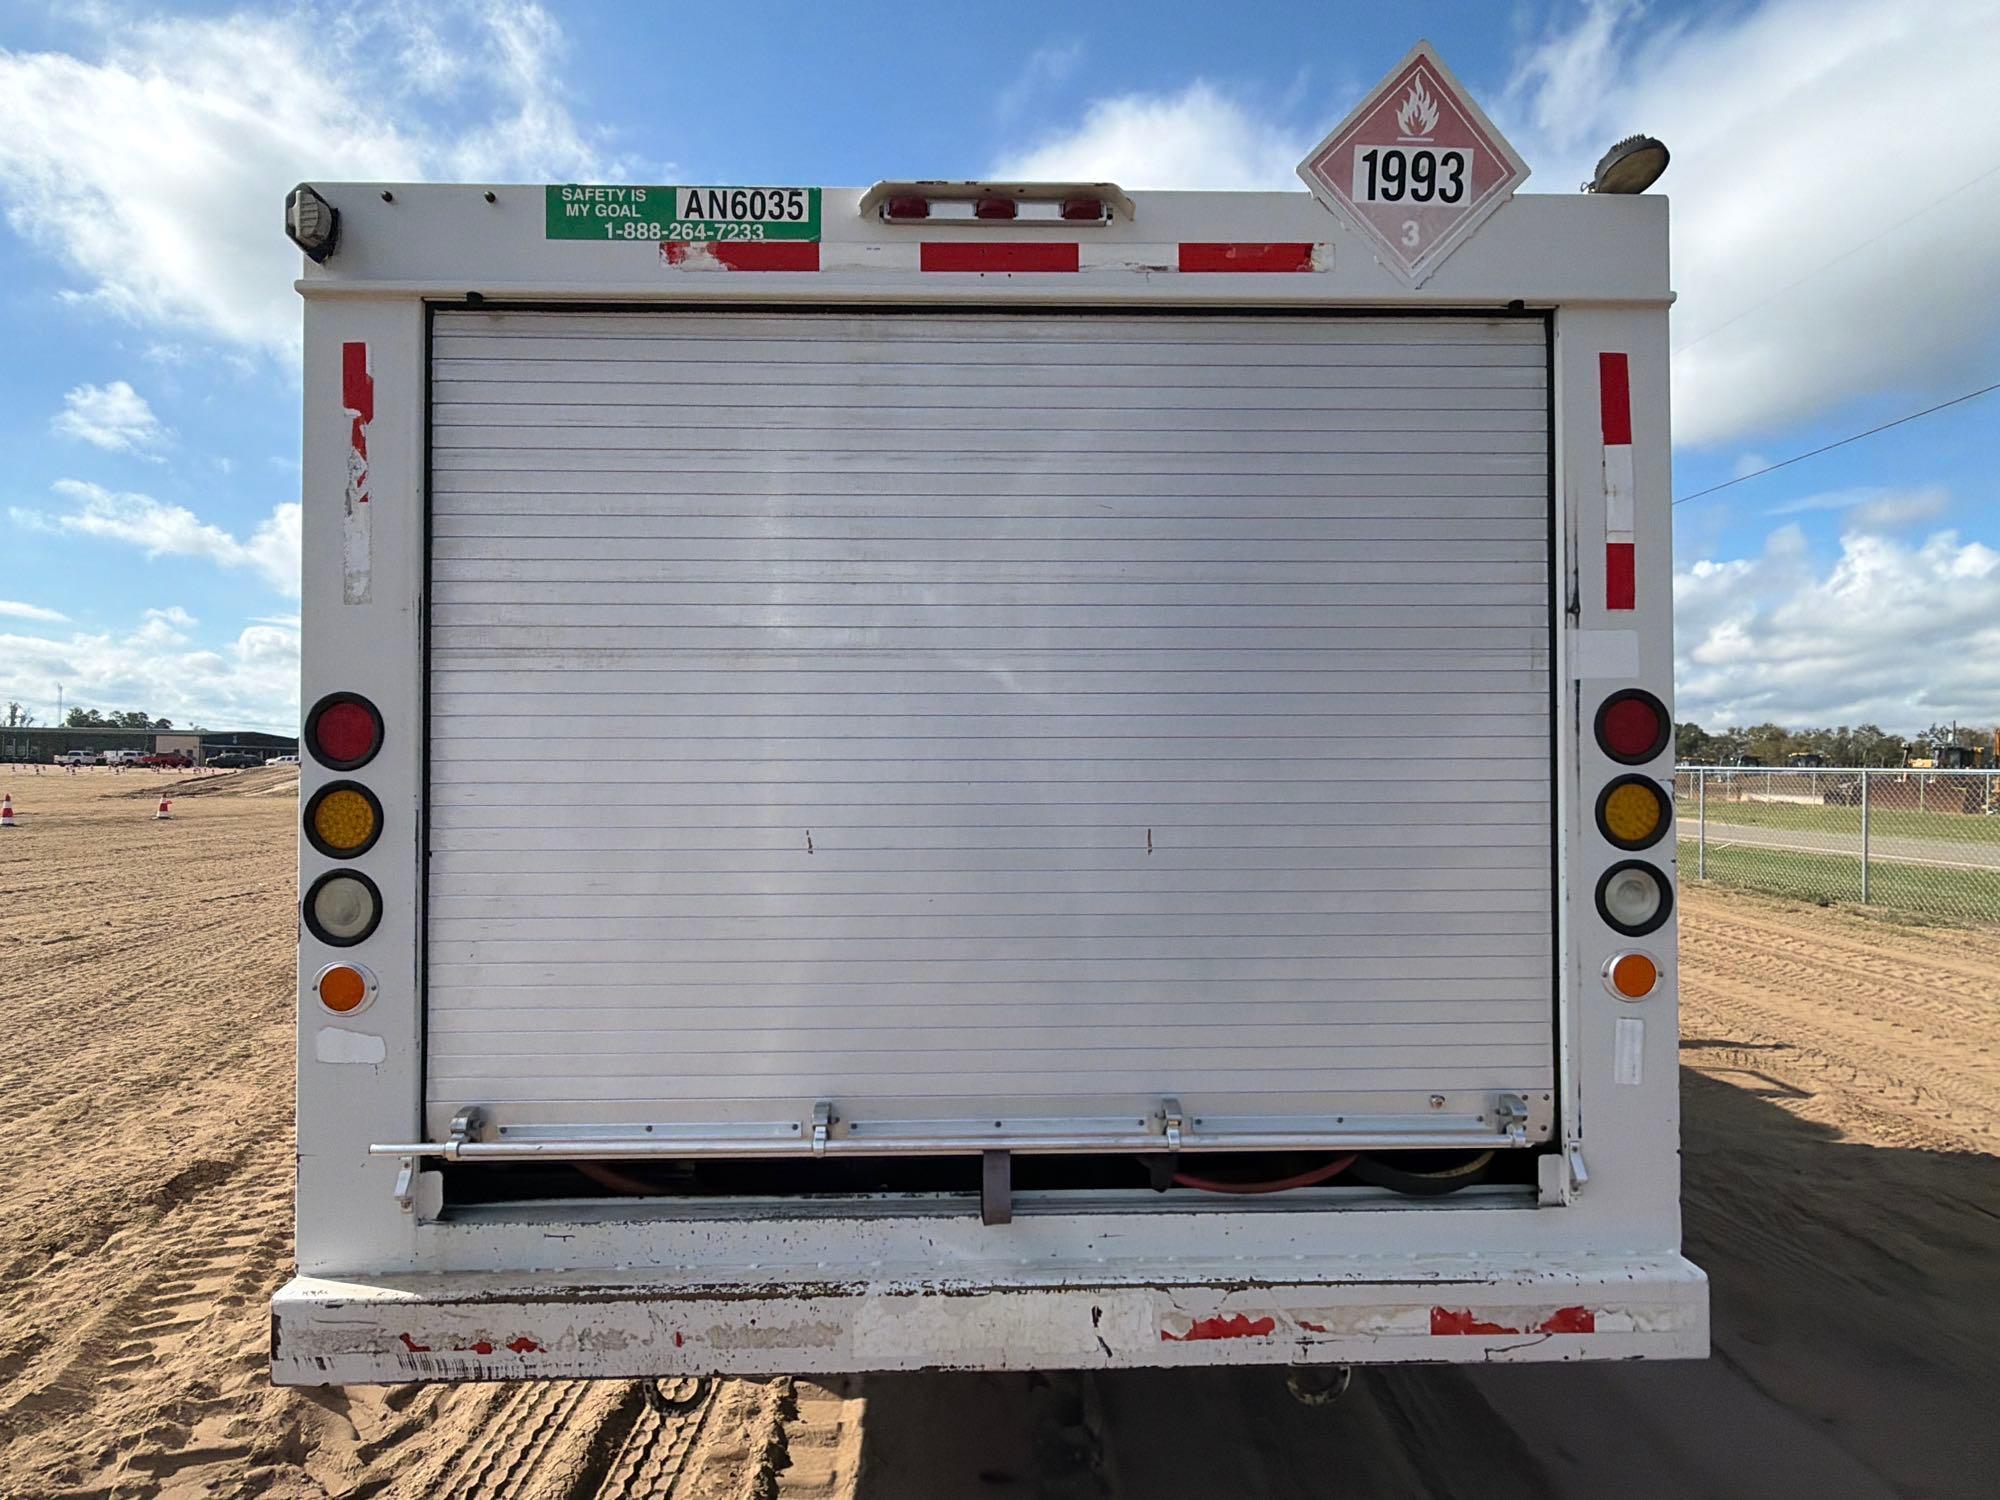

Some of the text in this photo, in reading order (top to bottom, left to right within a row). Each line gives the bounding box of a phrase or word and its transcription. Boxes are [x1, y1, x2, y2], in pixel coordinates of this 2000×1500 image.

[1362, 150, 1465, 204] 1993
[561, 188, 646, 202] SAFETY IS
[684, 190, 804, 221] AN6035
[566, 204, 642, 218] MY GOAL
[604, 222, 765, 241] 1-888-264-7233
[1401, 220, 1420, 247] 3
